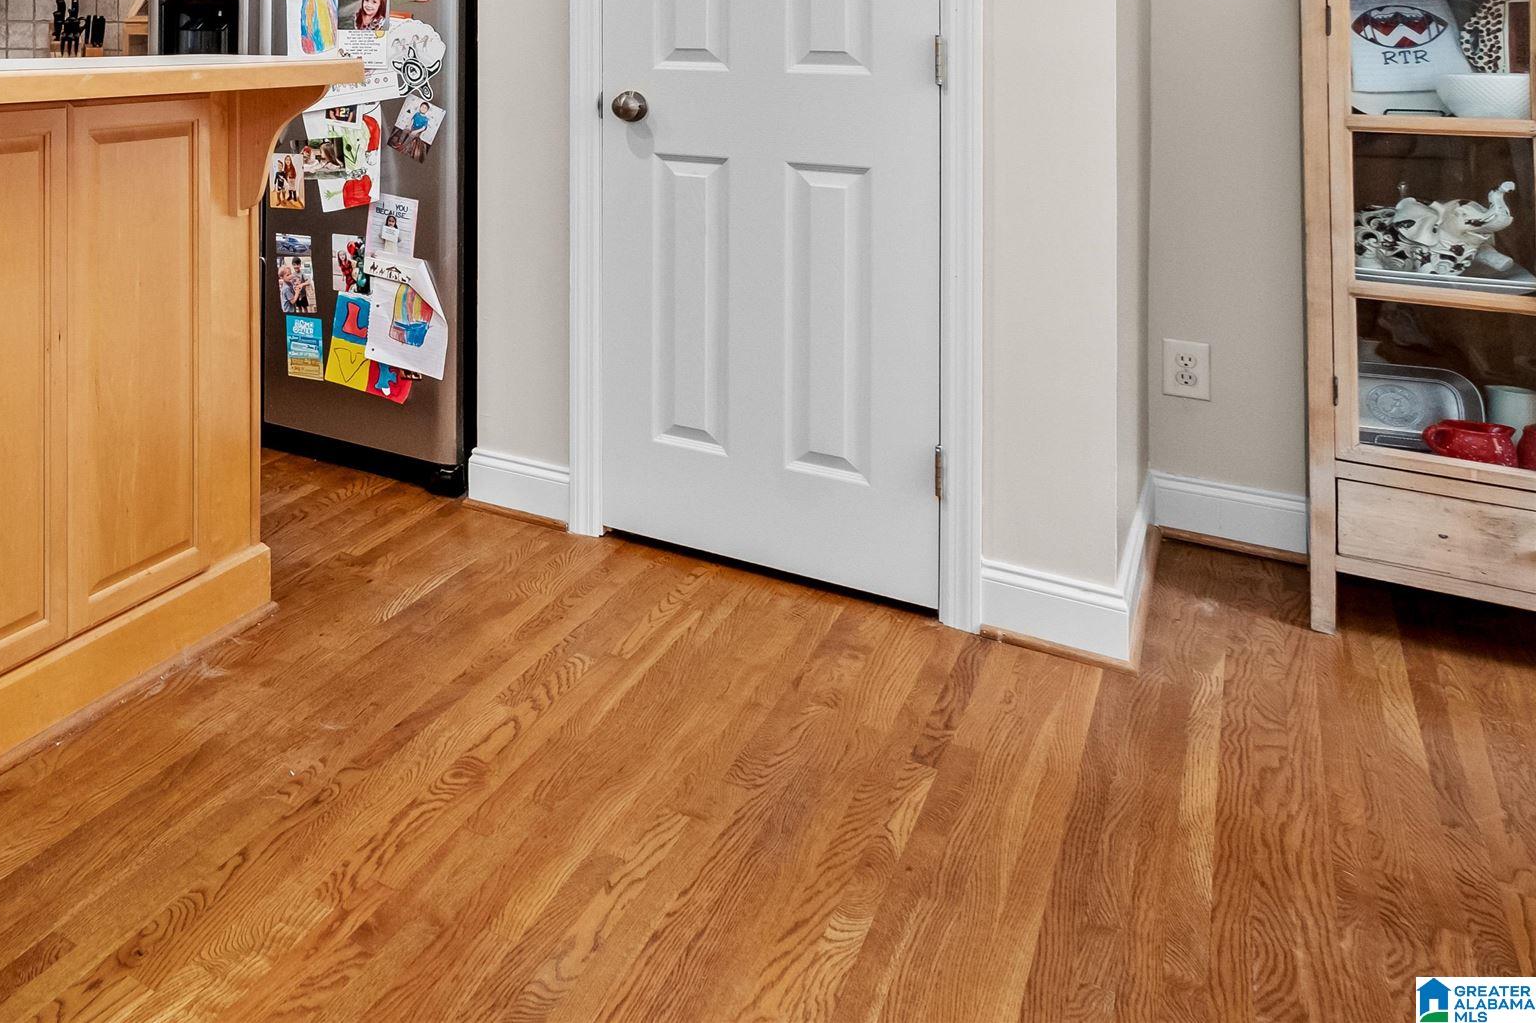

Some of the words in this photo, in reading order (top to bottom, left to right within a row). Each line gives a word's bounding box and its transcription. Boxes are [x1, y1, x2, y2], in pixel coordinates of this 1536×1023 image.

[1381, 49, 1430, 66] RTR
[375, 206, 406, 219] BECAUSE
[395, 203, 408, 213] YOU
